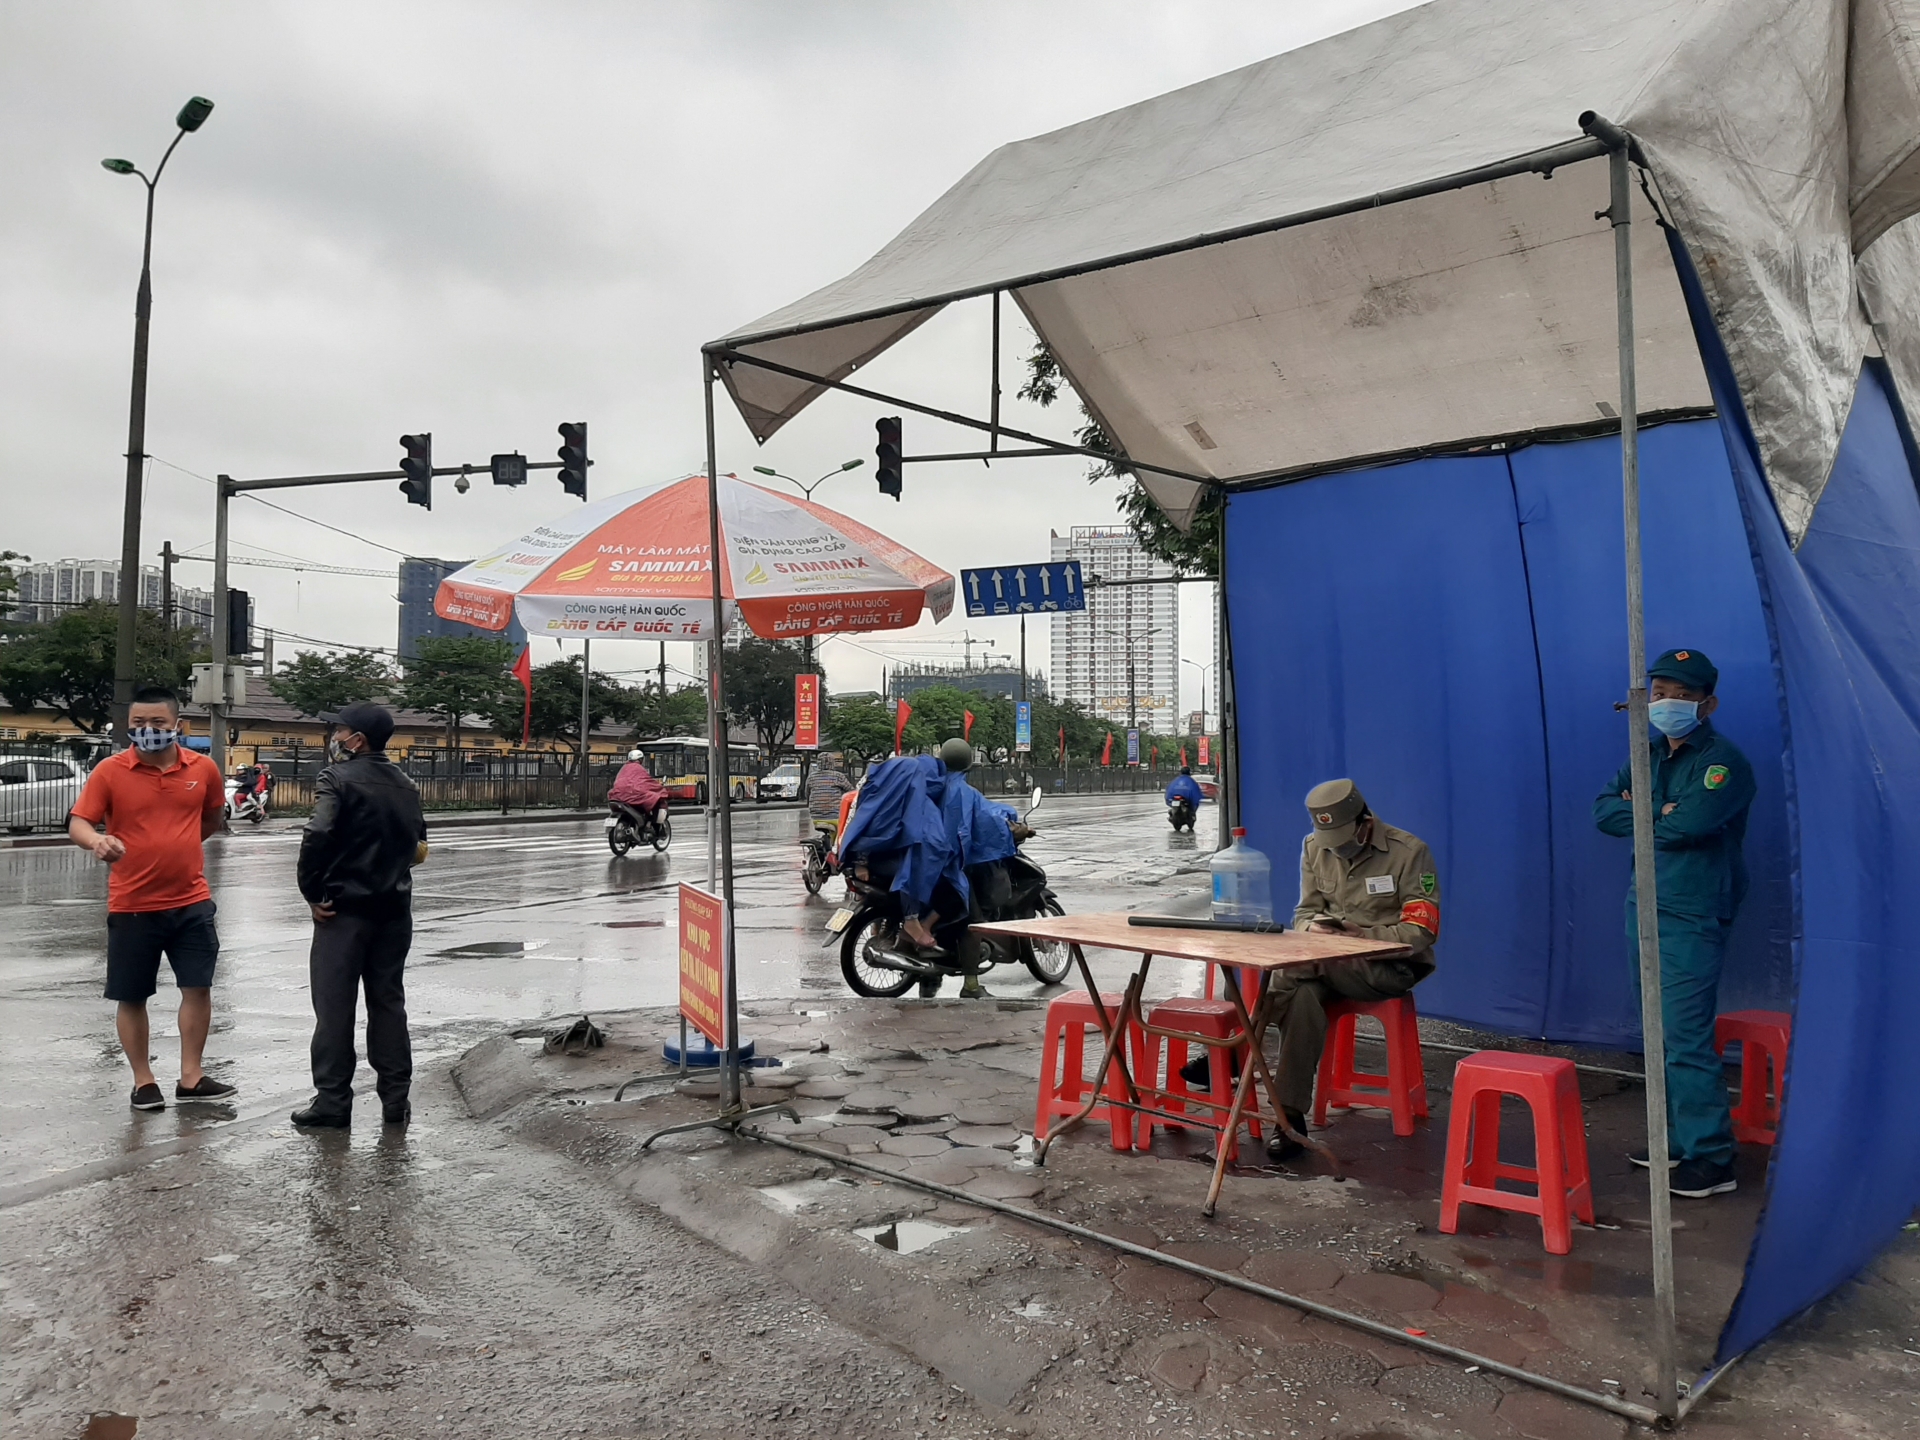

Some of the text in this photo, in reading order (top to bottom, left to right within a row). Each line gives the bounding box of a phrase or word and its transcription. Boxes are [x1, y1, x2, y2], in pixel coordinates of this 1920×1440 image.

[733, 533, 839, 548] ĐIỆN DÂN DỤNG VÀ
[597, 544, 635, 555] MÁY
[638, 545, 671, 556] LÀM
[738, 542, 847, 557] GIA DỤNG CAO CẤP
[608, 560, 713, 573] SAMMAX
[773, 556, 870, 574] SAMMAX
[594, 586, 672, 594] sammax.vn
[565, 602, 687, 616] CÔNG NGHỆ HÀN QUỐC
[787, 596, 891, 614] CÔNG NGHỆ HÀN QUỐC
[816, 610, 844, 627] CẤP
[848, 609, 882, 626] QUỐC
[887, 608, 903, 624] TẾ
[596, 616, 628, 632] CẤP
[633, 618, 674, 634] QUỐC
[681, 619, 702, 635] TẾ
